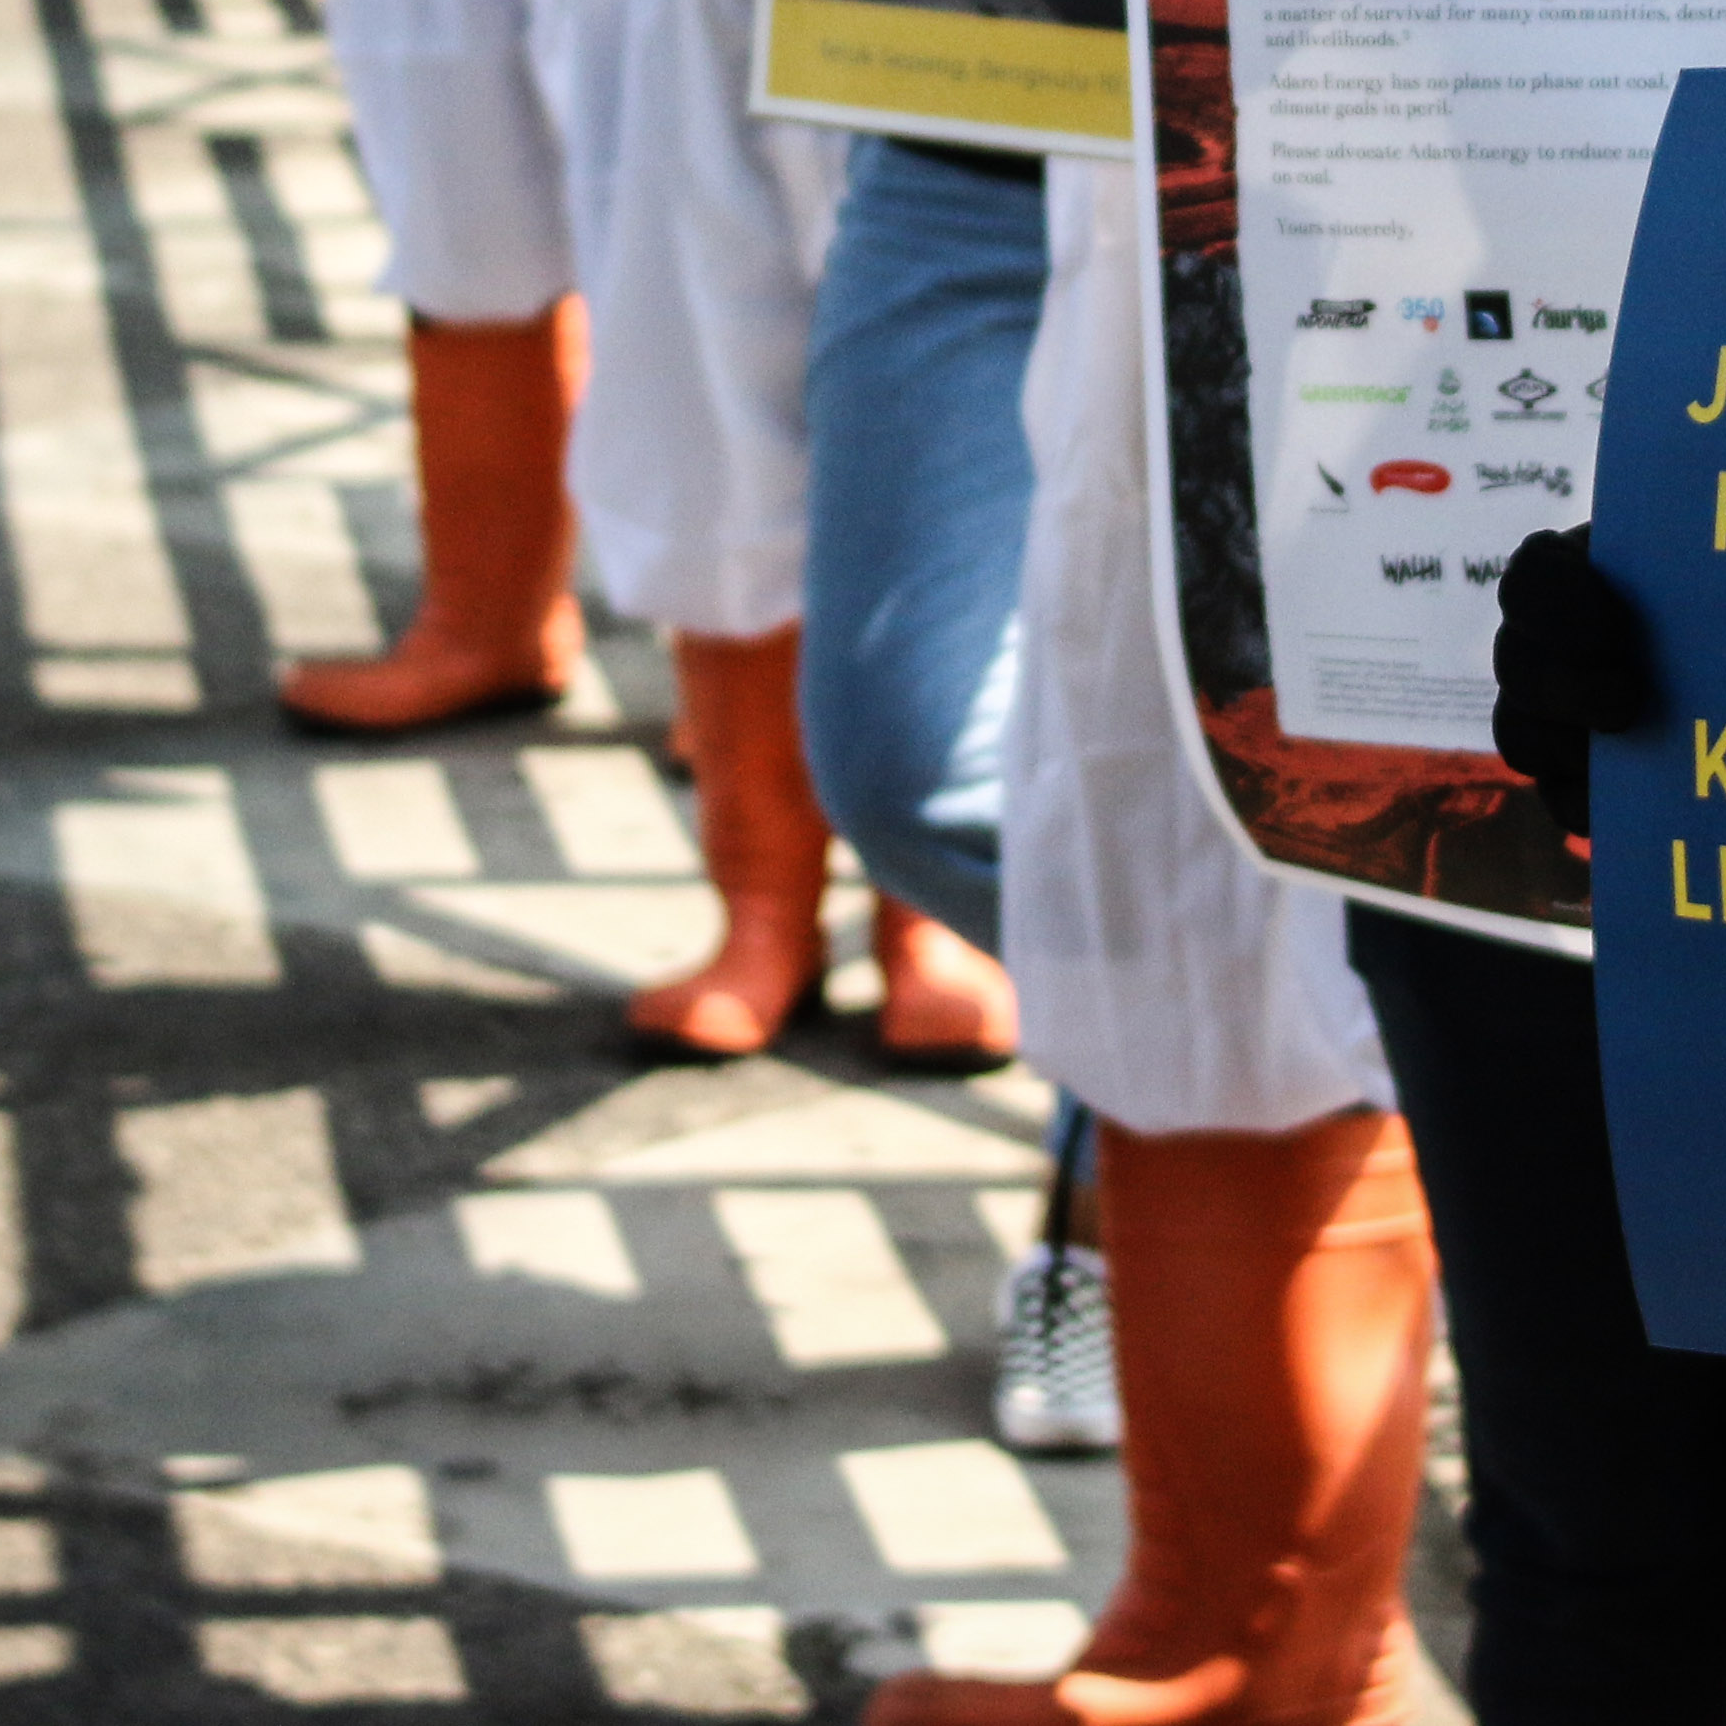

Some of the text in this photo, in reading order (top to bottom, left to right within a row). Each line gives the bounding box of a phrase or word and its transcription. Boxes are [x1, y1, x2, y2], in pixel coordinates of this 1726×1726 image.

[1264, 11, 1272, 21] a
[1278, 8, 1332, 21] matter
[1341, 5, 1358, 21] of
[1365, 5, 1441, 21] survival
[1447, 5, 1474, 20] for
[1481, 10, 1530, 25] many
[1266, 32, 1294, 47] and
[1271, 74, 1319, 90] Adaro
[1324, 75, 1383, 94] Energy
[1392, 74, 1420, 90] has
[1427, 77, 1448, 89] no
[1453, 73, 1498, 92] plans
[1507, 74, 1525, 89] to
[1531, 73, 1583, 92] phase
[1590, 74, 1620, 89] out
[1270, 100, 1330, 116] climate
[1336, 100, 1376, 119] goals
[1384, 101, 1401, 116] in
[1272, 144, 1319, 159] Please
[1326, 144, 1401, 159] advocate
[1409, 144, 1461, 159] Adaro
[1467, 144, 1530, 163] Energy
[1538, 145, 1554, 159] to
[1560, 143, 1621, 159] reduce
[1272, 171, 1291, 184] on
[1277, 219, 1324, 235] Yours
[1399, 297, 1444, 320] 350
